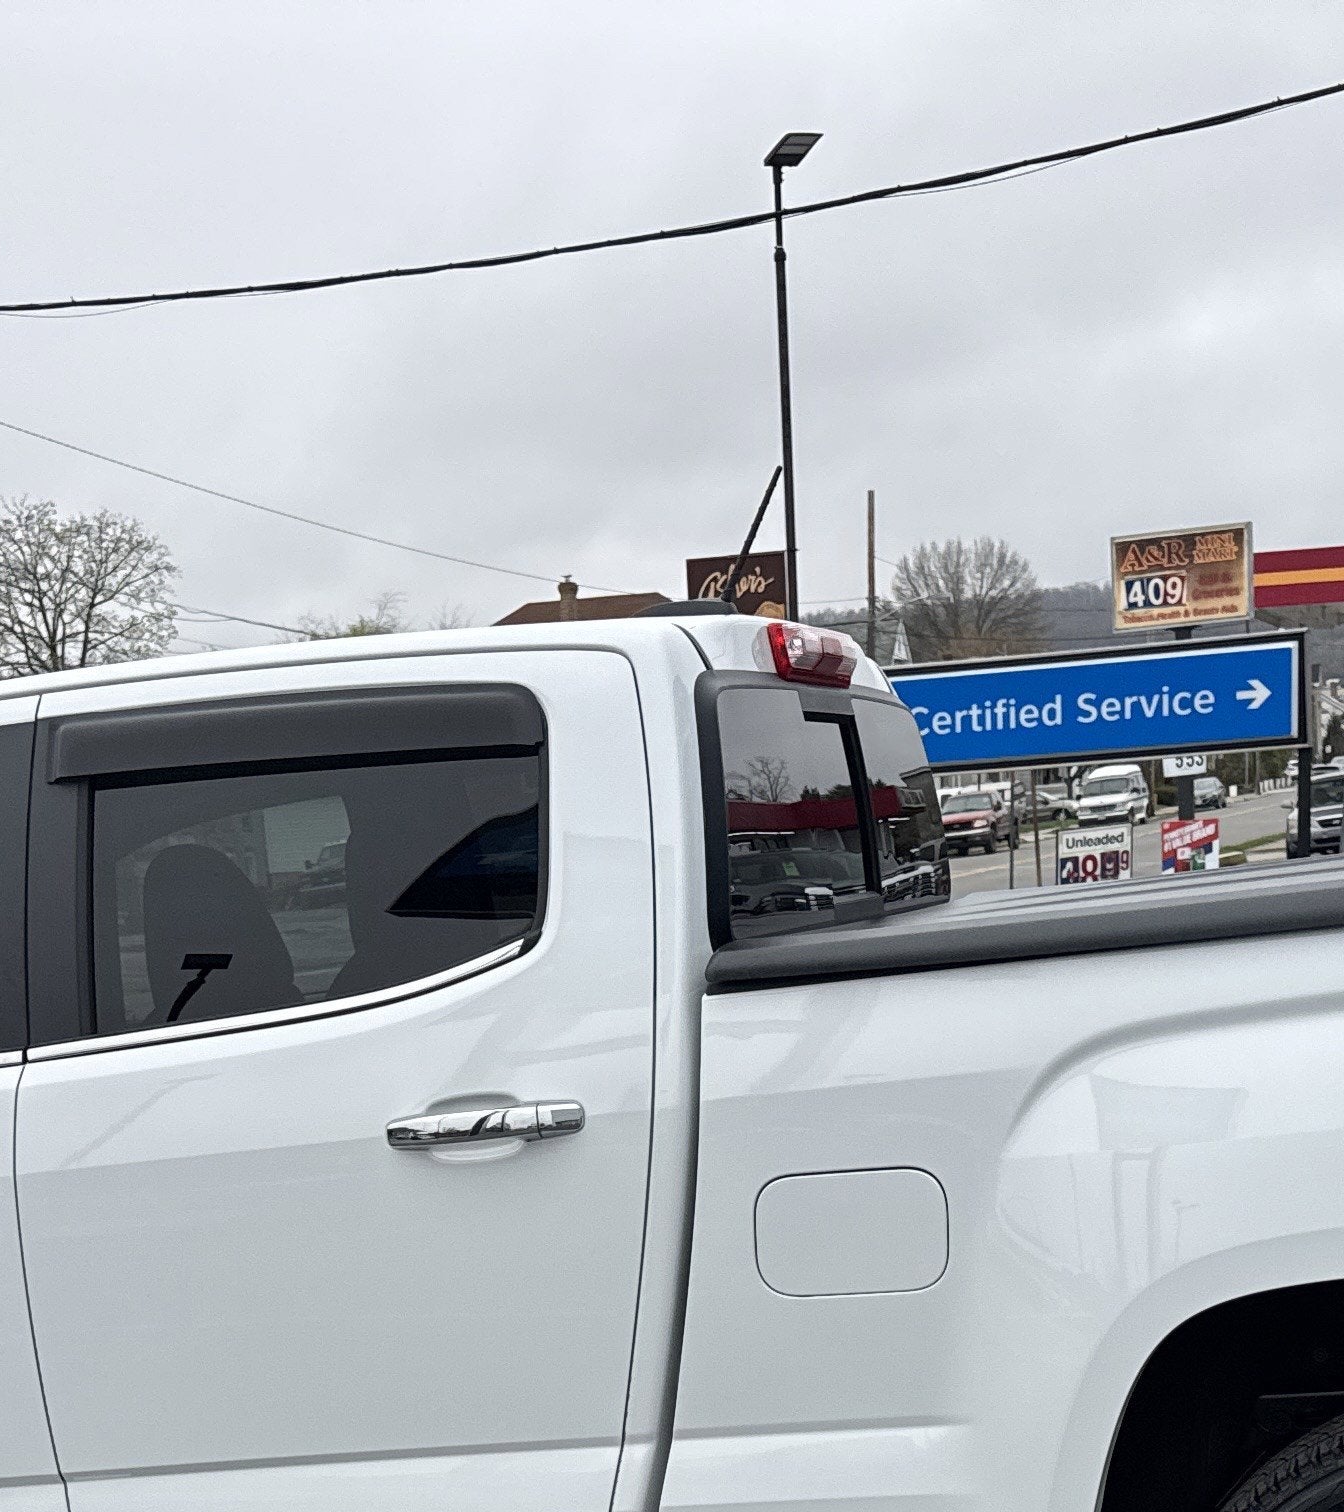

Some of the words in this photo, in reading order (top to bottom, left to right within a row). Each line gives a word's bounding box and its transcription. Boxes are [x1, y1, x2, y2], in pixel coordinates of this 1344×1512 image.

[1194, 532, 1235, 547] MINI
[1120, 540, 1189, 572] A&R
[1192, 546, 1238, 563] MART
[911, 695, 1062, 736] Certified
[1076, 686, 1216, 724] Service
[1066, 833, 1124, 849] Unleaded
